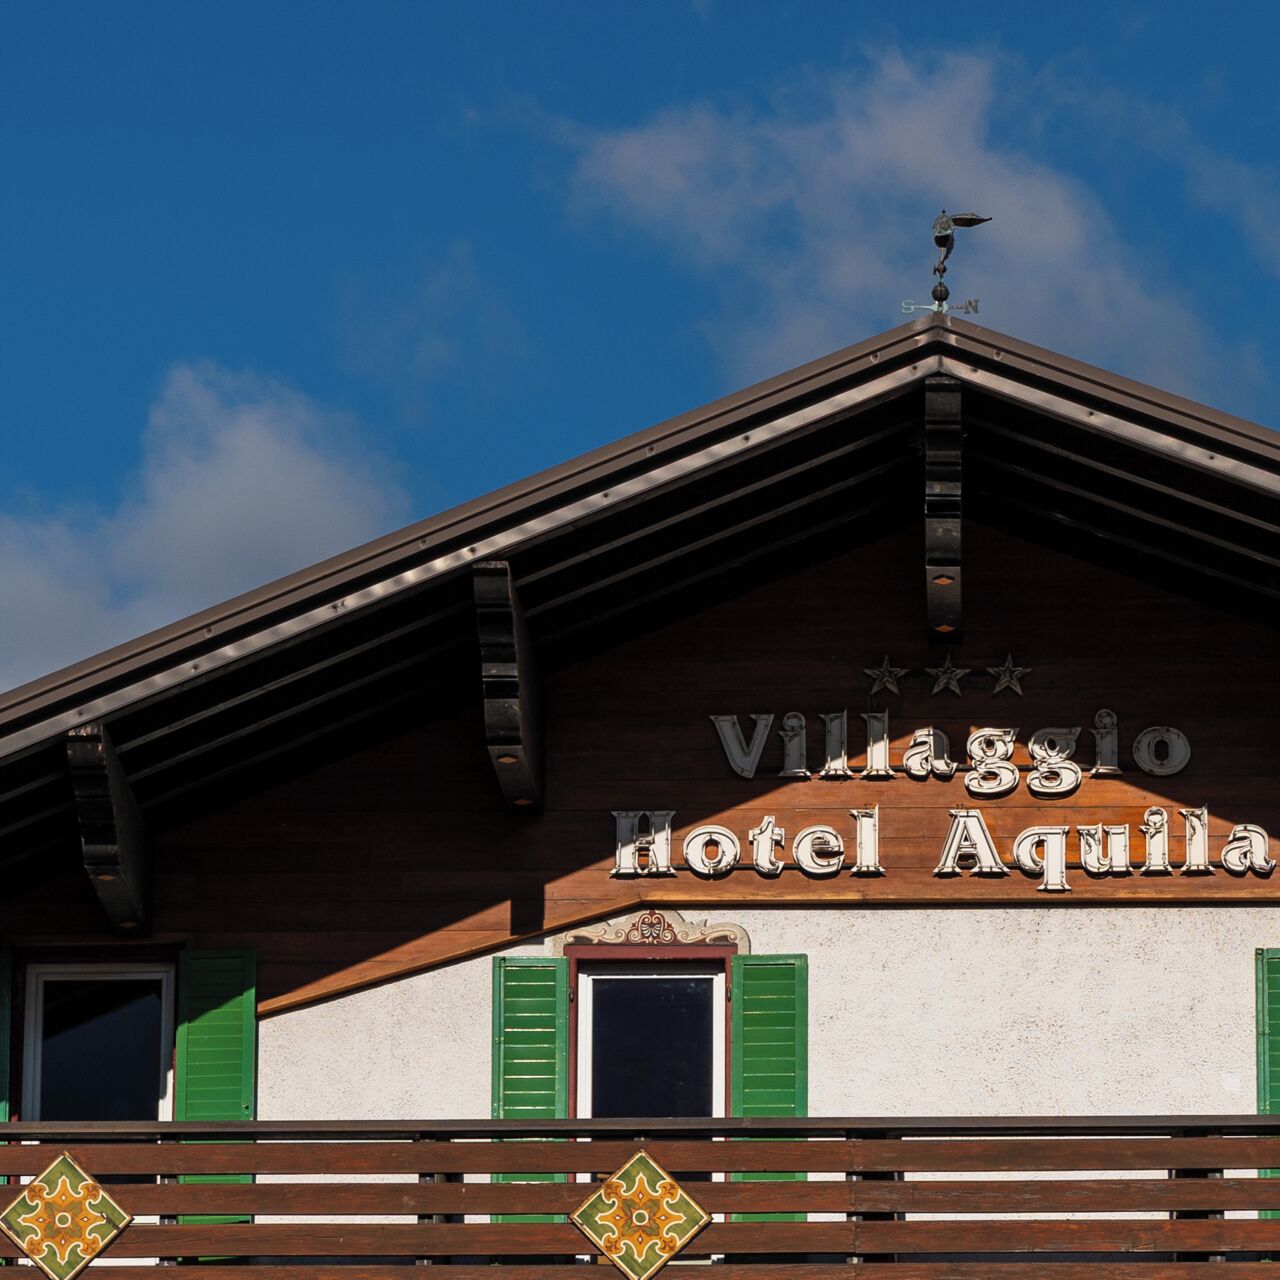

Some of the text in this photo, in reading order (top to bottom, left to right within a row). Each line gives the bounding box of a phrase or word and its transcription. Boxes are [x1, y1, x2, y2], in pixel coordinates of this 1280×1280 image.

[901, 300, 914, 314] S
[964, 299, 980, 314] N
[709, 708, 1191, 797] Villaggio
[610, 804, 1277, 892] Hotel Aquila
